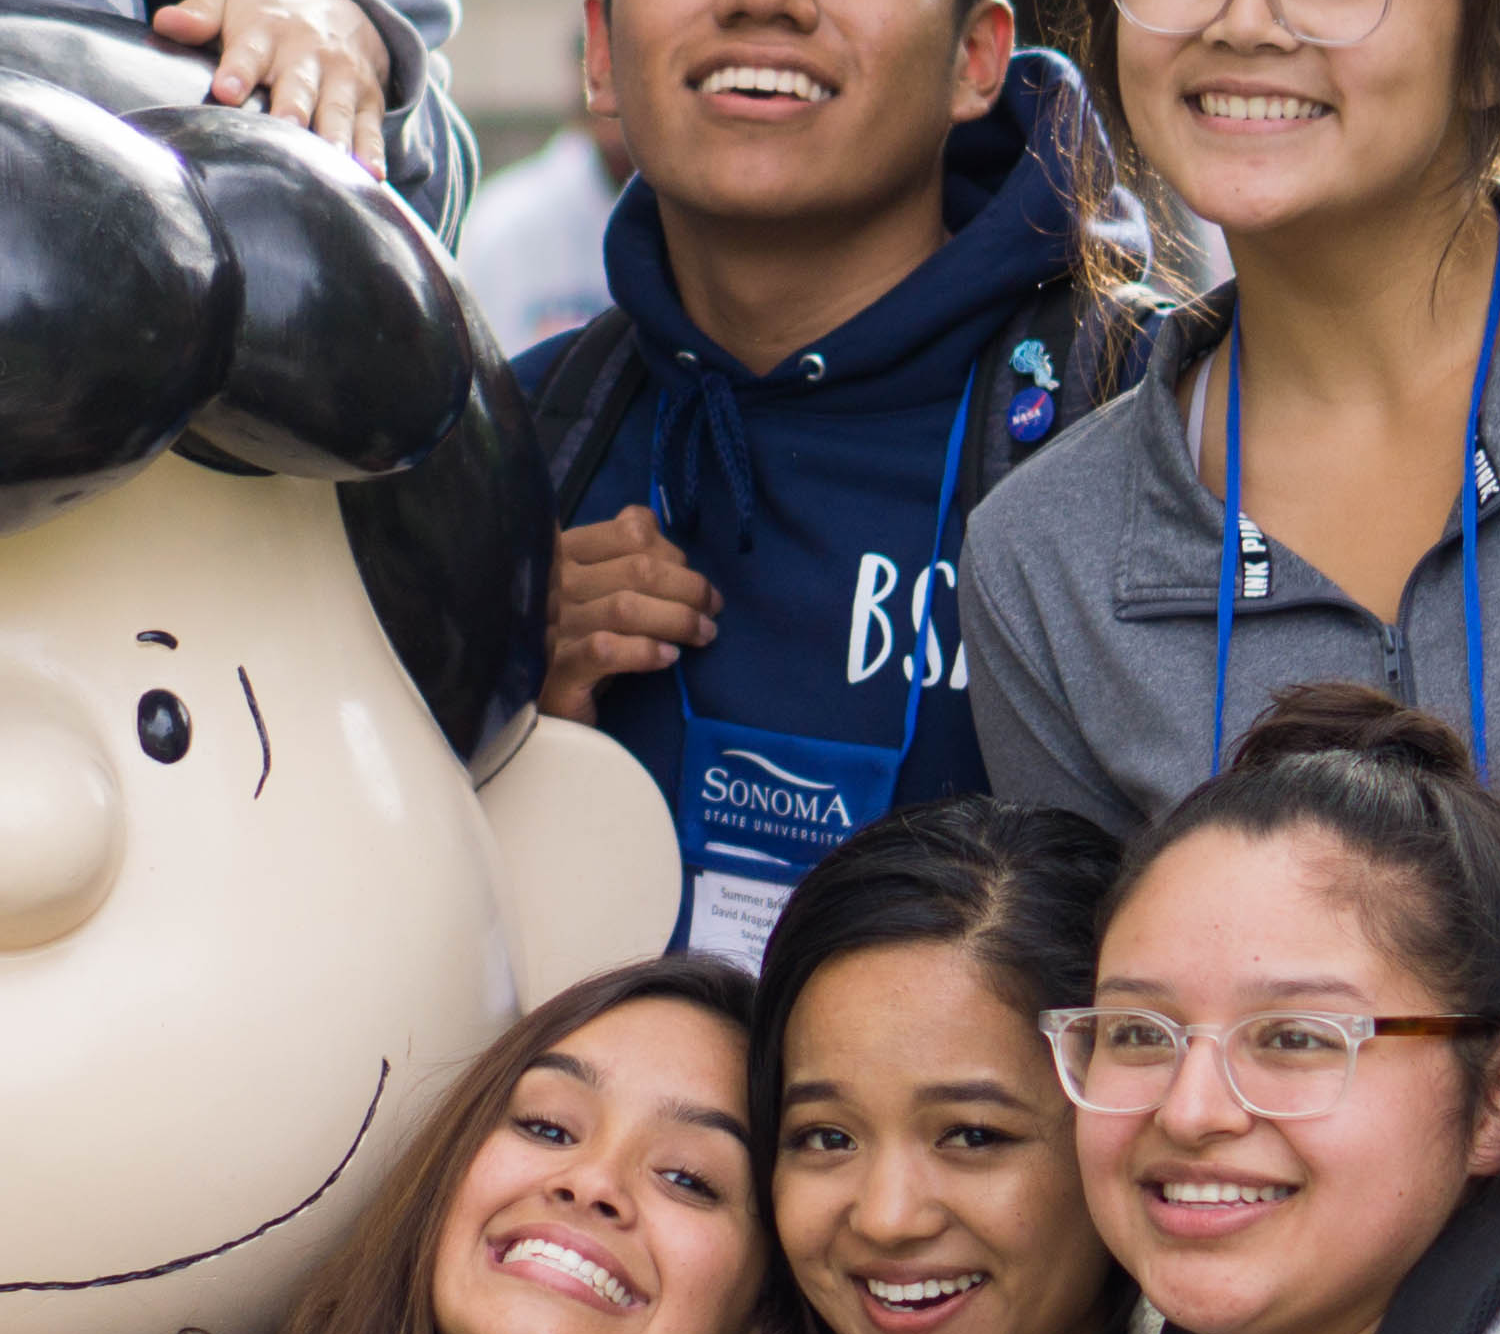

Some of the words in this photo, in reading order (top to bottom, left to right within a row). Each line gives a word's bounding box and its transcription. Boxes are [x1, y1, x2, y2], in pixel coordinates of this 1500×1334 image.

[1012, 408, 1041, 426] NASA
[847, 553, 969, 690] BS
[701, 767, 853, 827] SONOMA
[704, 809, 747, 828] STATE
[754, 820, 846, 844] UNIVERSITY
[720, 886, 764, 907] Summer
[711, 903, 738, 919] David
